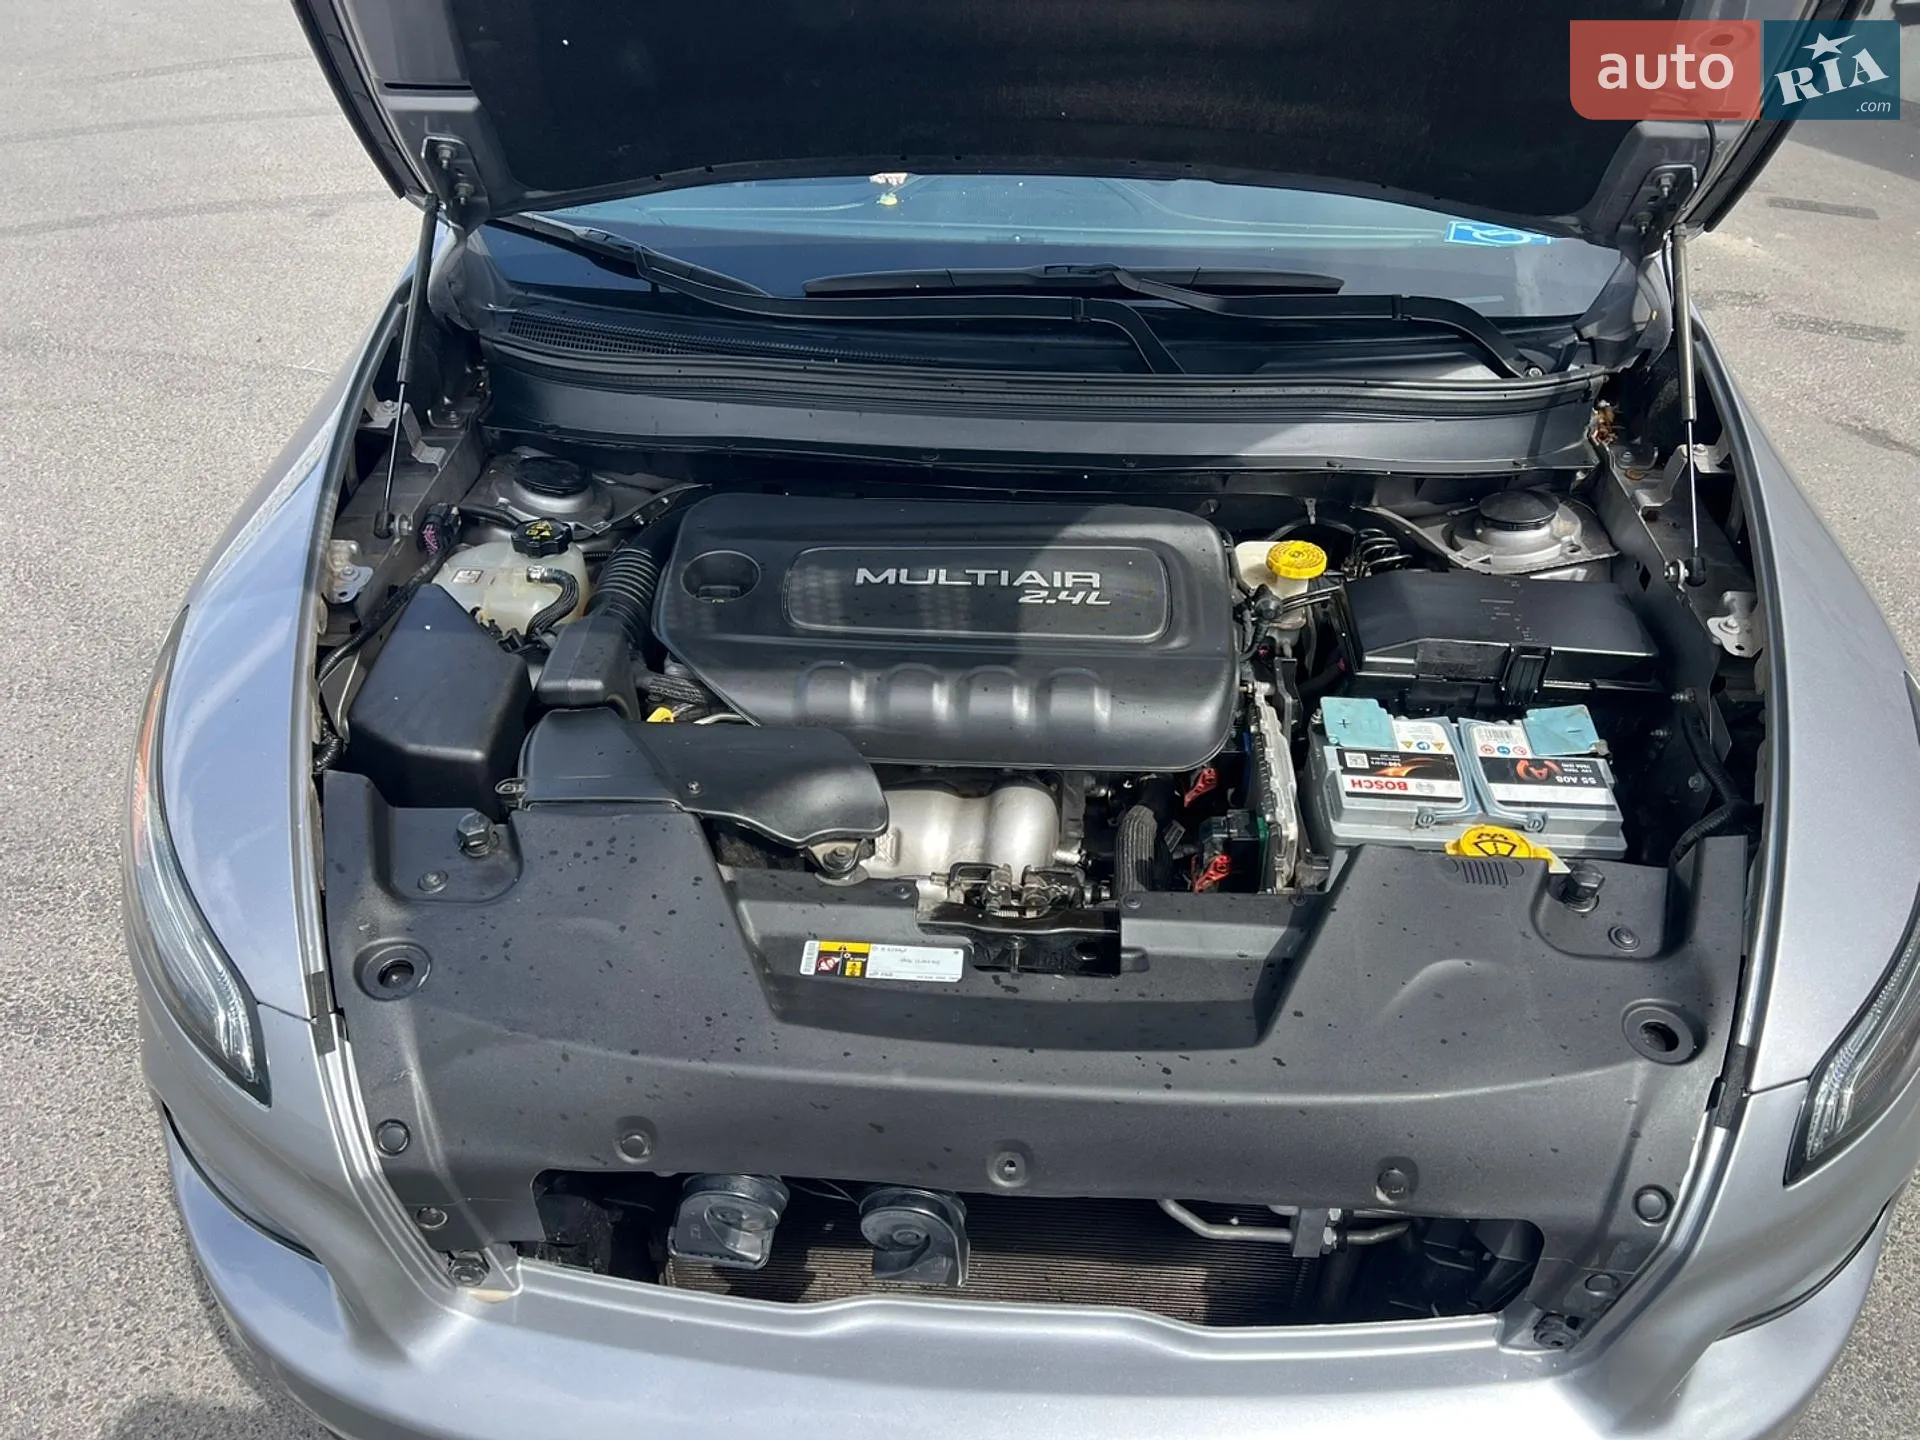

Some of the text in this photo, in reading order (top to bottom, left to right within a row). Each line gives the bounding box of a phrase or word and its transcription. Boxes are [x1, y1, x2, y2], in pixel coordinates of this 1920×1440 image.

[855, 567, 1101, 588] MULTIAIR
[1018, 590, 1111, 605] 2.4L
[1351, 779, 1408, 791] BOSCH
